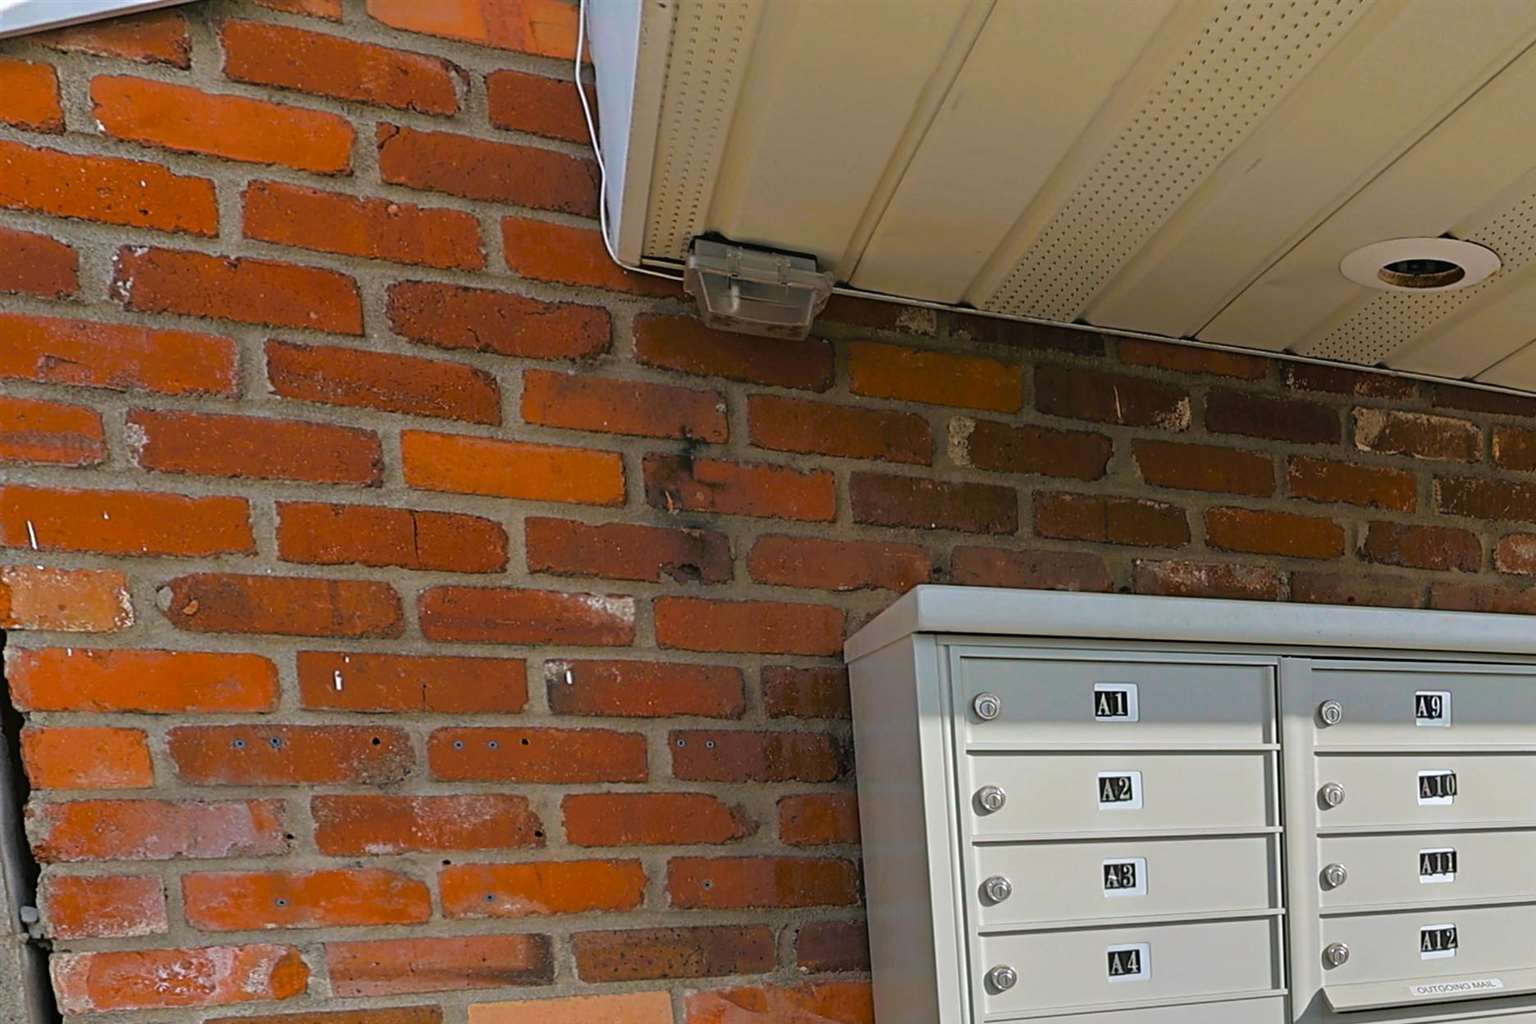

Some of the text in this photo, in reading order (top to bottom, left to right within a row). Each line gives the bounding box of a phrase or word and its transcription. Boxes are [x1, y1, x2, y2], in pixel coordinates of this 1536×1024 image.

[1097, 692, 1126, 716] A1
[1417, 696, 1441, 717] A9
[1101, 777, 1131, 801] A2
[1421, 774, 1456, 797] A10
[1421, 852, 1455, 874] A11
[1106, 864, 1135, 888] A3
[1422, 928, 1457, 951] A12
[1110, 950, 1139, 975] A4
[1416, 980, 1497, 994] OUTGOING MAIL
